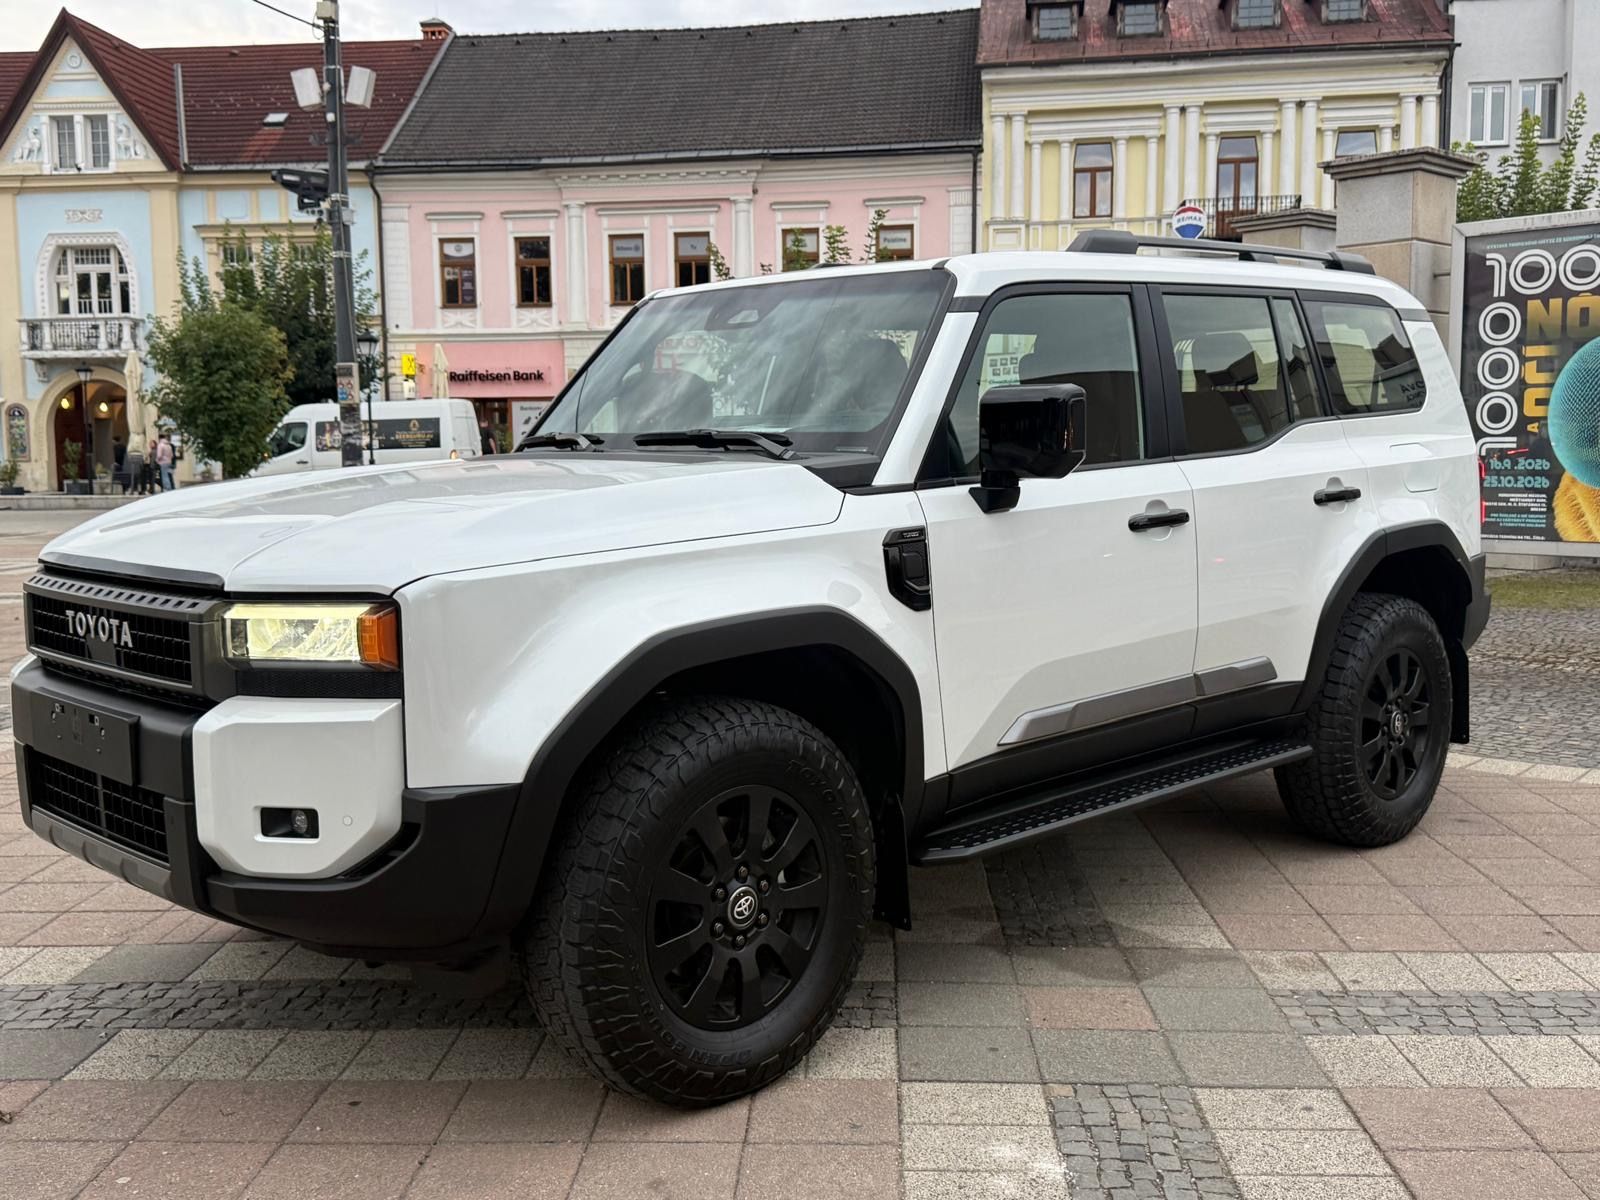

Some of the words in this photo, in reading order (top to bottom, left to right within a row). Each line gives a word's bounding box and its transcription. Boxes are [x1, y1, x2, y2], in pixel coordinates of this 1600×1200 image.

[449, 369, 511, 383] Raiffeisen
[513, 369, 545, 382] Bank
[1483, 475, 1550, 488] 25.10.2026
[65, 610, 133, 648] TOYOTA
